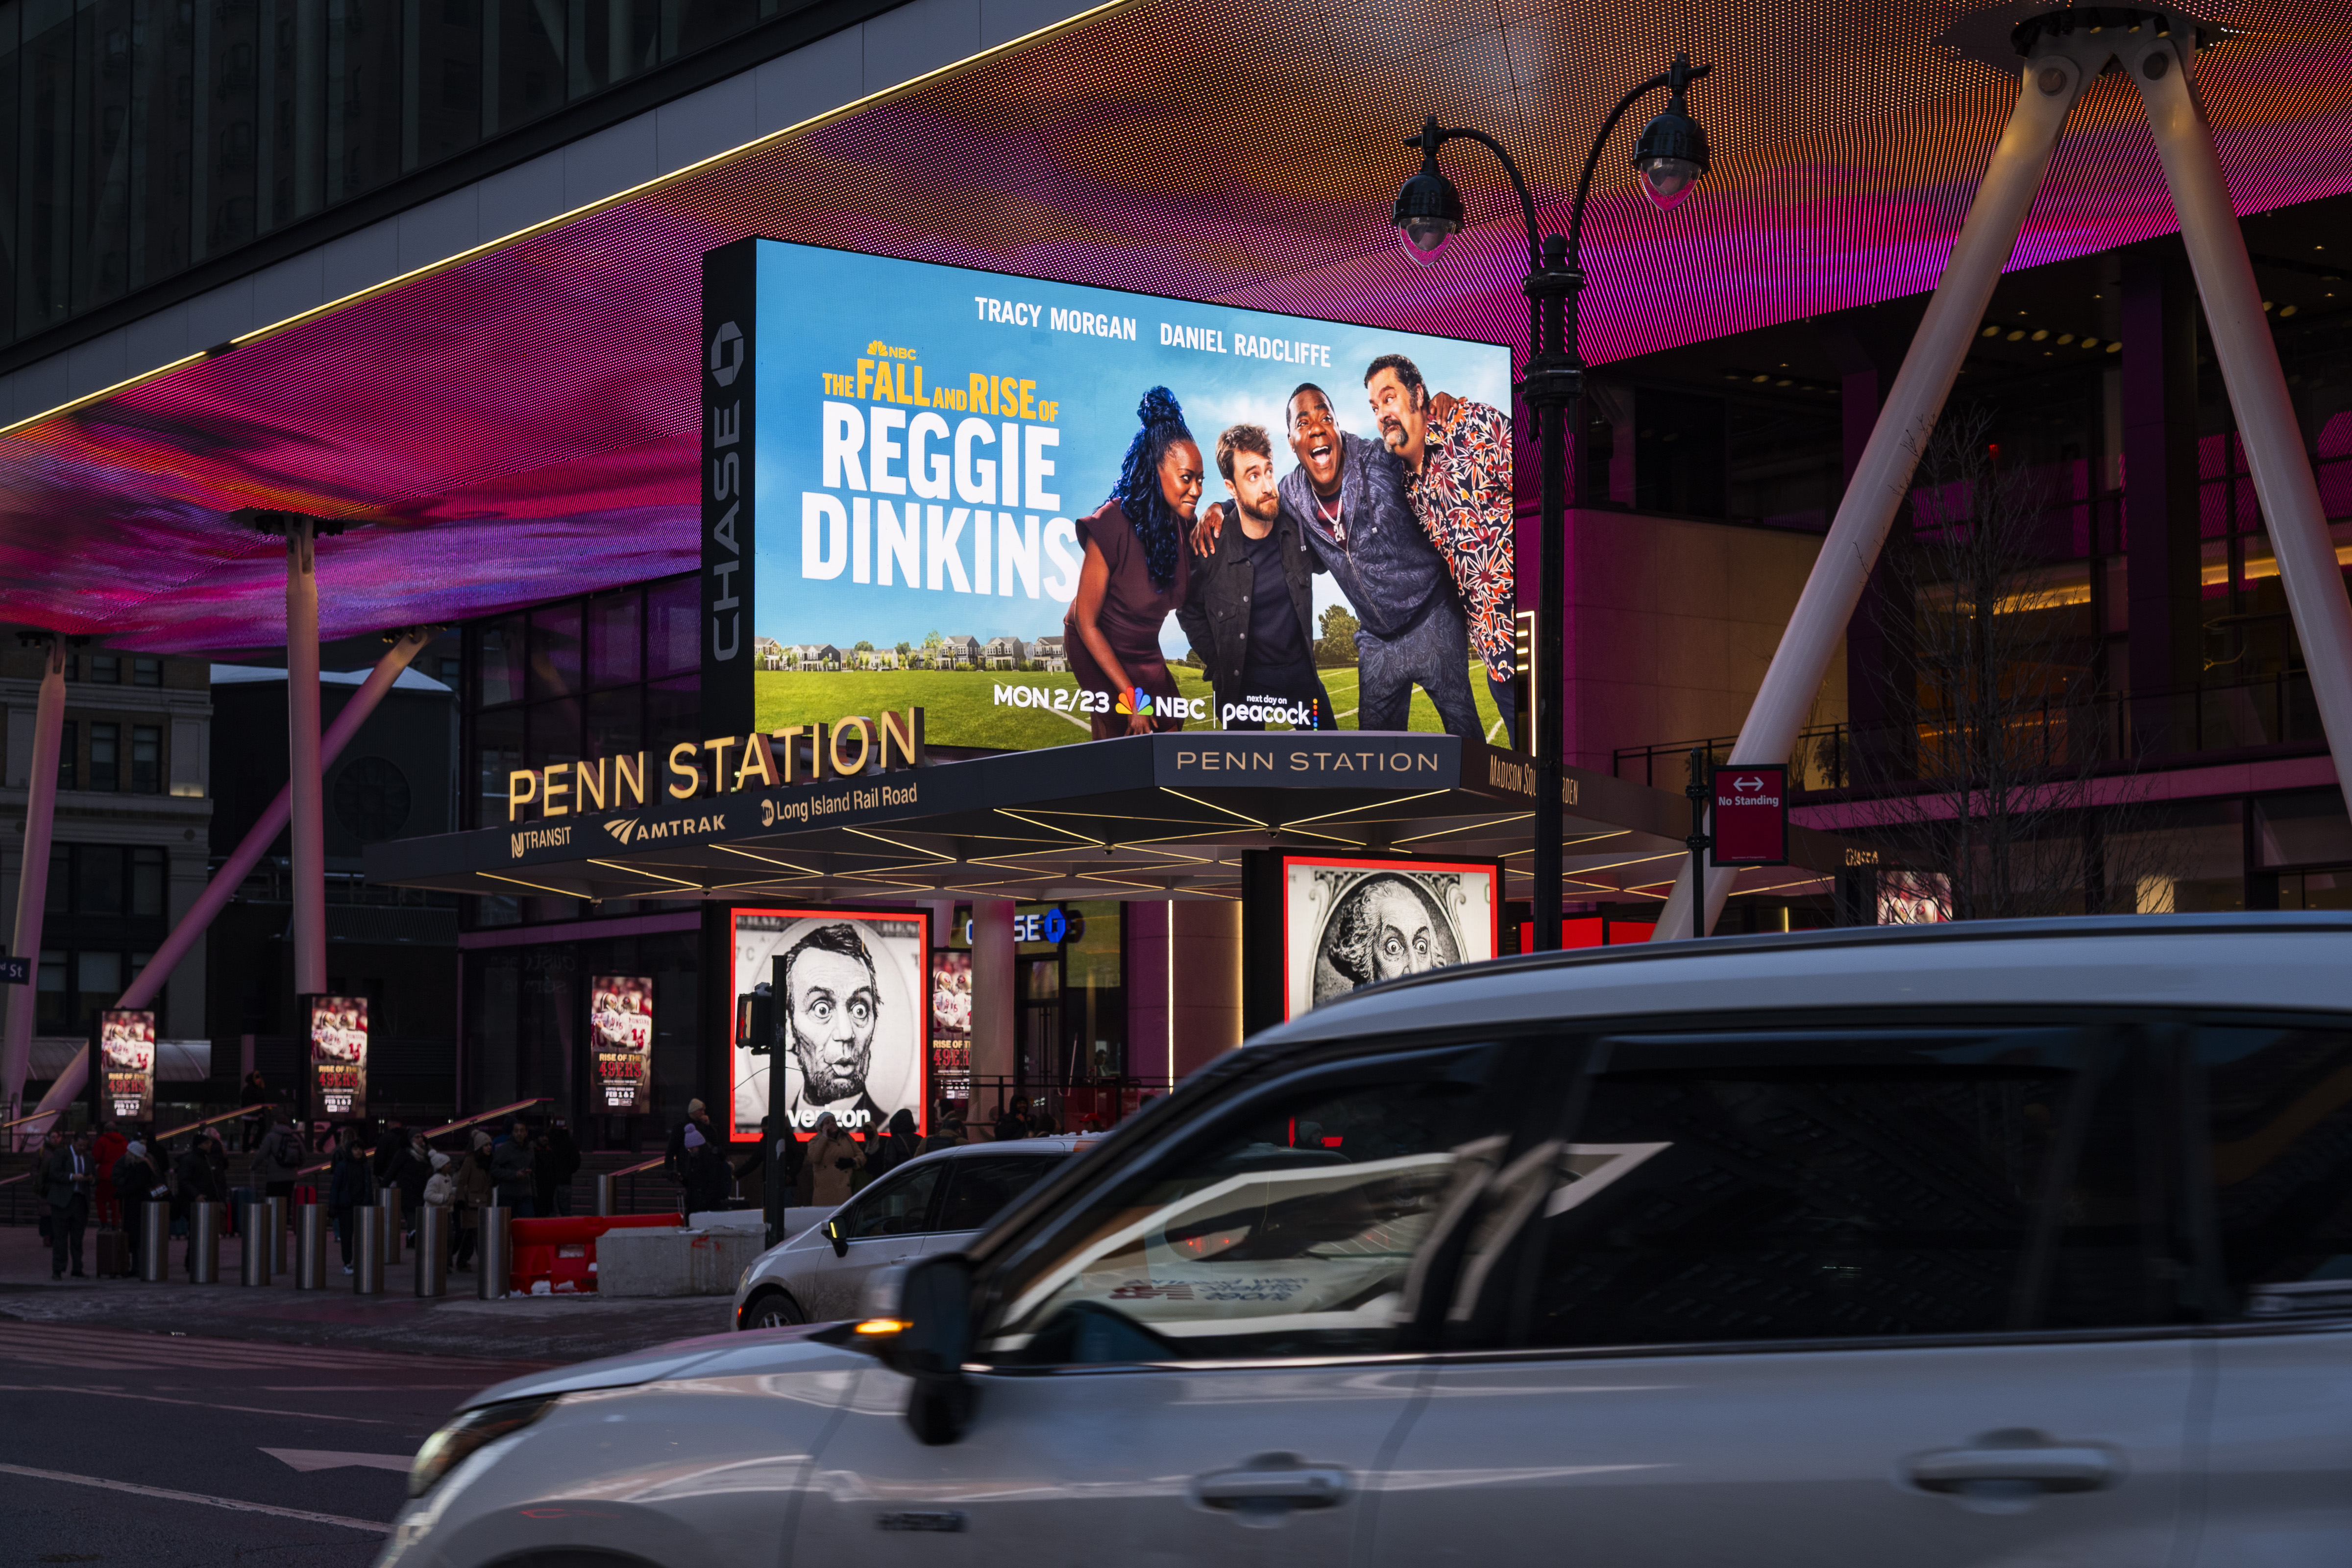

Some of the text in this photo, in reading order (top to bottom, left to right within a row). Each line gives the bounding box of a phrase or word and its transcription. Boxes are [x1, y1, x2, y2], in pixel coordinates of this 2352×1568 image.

[975, 296, 1331, 368] TRACY MORGAN DANIEL RADCLIFFE
[889, 346, 916, 360] NBC
[822, 358, 1059, 422] THE FALL AND RISE OF
[822, 400, 1060, 512] REGGIE
[713, 399, 739, 662] CHASE
[802, 491, 1080, 604] DINKINS
[994, 684, 1206, 720] MON 2/23 NBC
[1263, 695, 1277, 706] day
[1223, 701, 1311, 730] peacock
[510, 707, 924, 822] PENN STATION
[1177, 752, 1438, 771] PENN STATION
[1490, 754, 1522, 792] MADISON
[777, 782, 917, 822] Long Island Rail Road
[1718, 795, 1779, 807] No Standing
[524, 826, 571, 849] TRANSIT
[636, 814, 726, 841] AMTRAK
[9, 963, 23, 978] St
[933, 1040, 951, 1048] RISE
[952, 1040, 963, 1049] OF
[599, 1053, 616, 1061] RISE
[933, 1049, 970, 1066] 49ER
[318, 1073, 358, 1086] 49ERS
[599, 1061, 641, 1078] 49ERS
[109, 1080, 145, 1093] 49ERS
